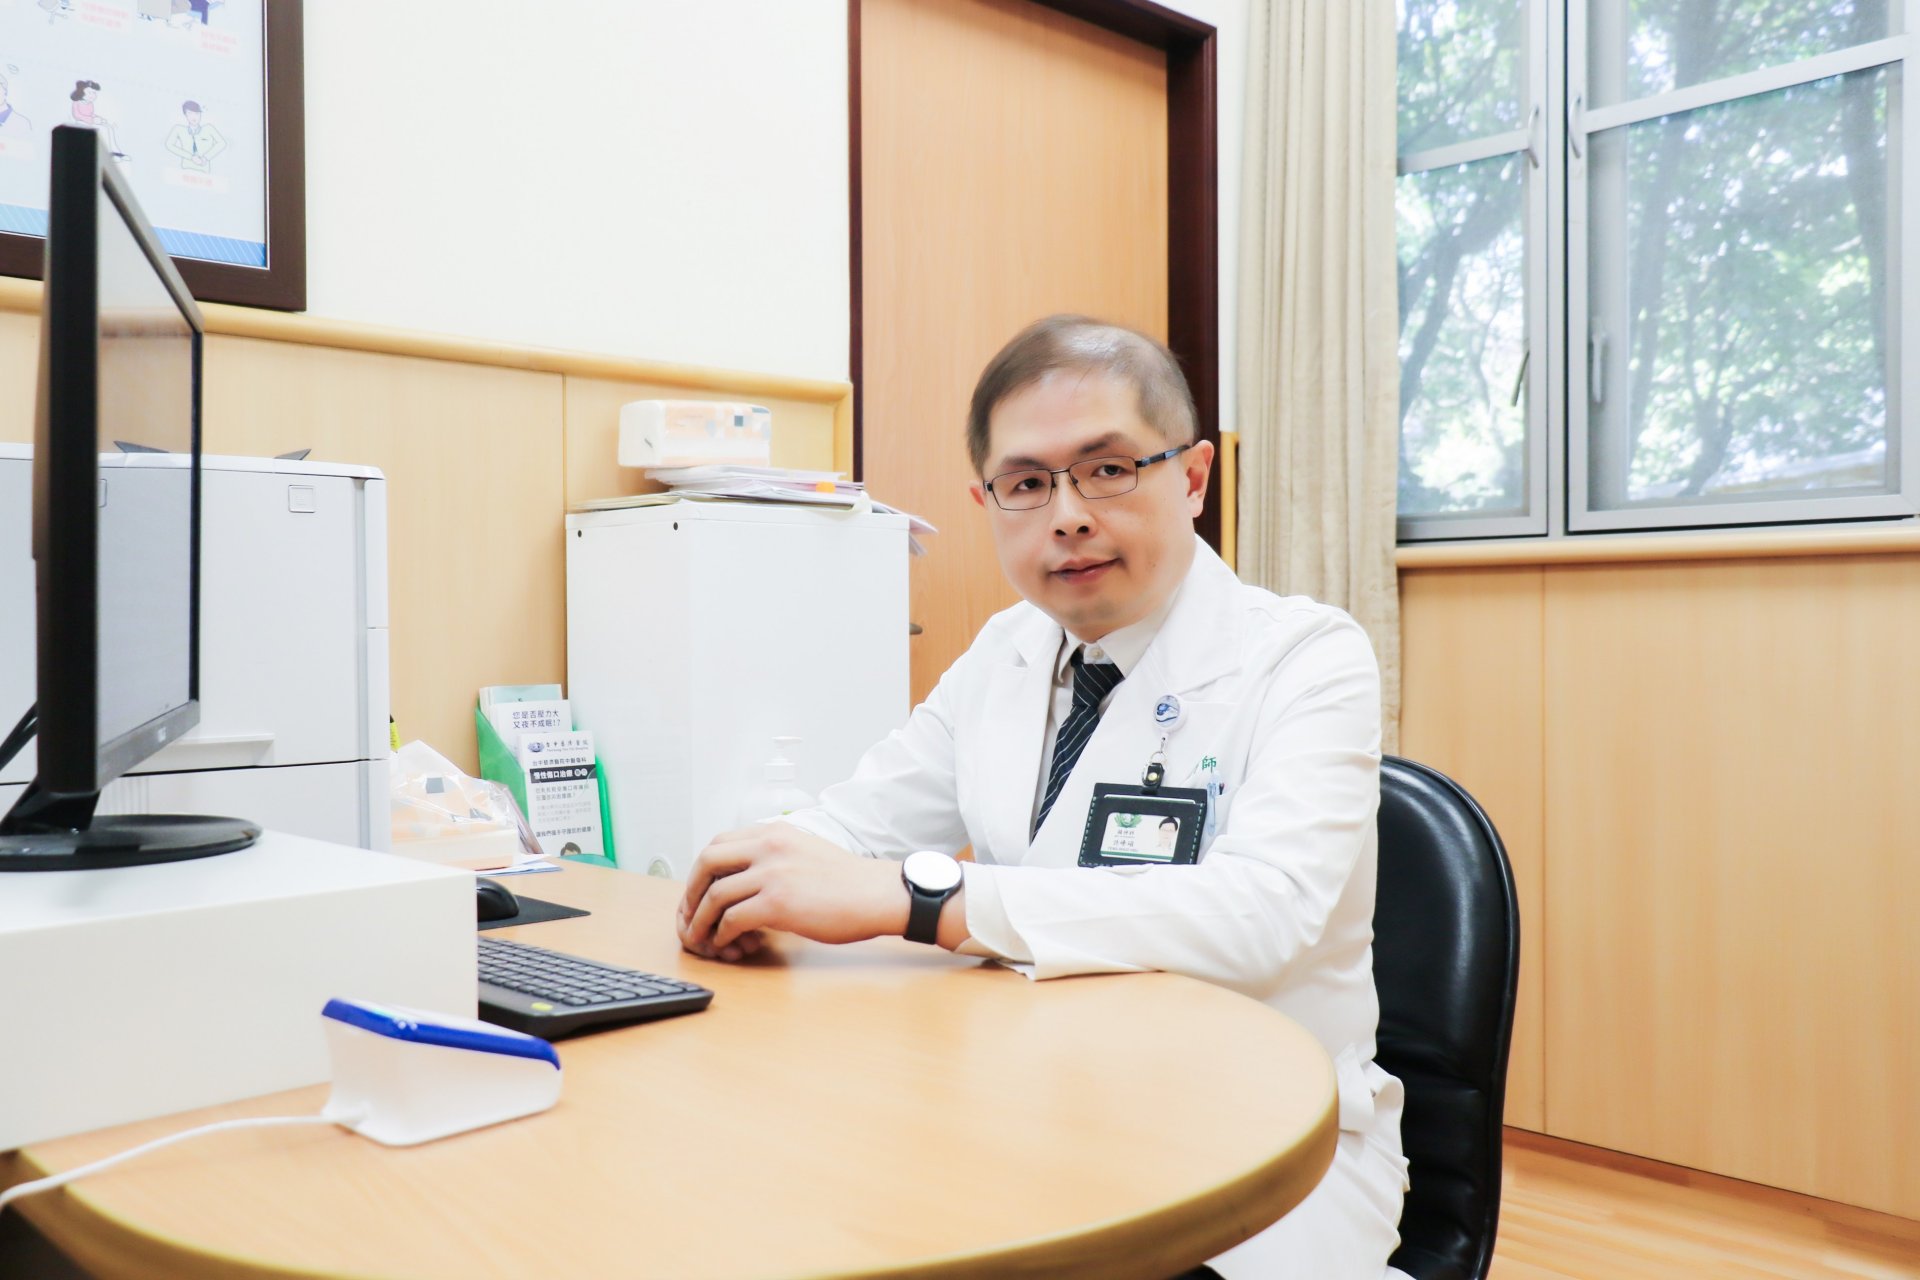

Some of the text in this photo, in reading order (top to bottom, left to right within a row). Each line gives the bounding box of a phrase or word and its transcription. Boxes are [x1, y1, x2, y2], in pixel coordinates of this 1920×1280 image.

[512, 708, 559, 719] 您是否壓力大
[1201, 755, 1217, 774] 師
